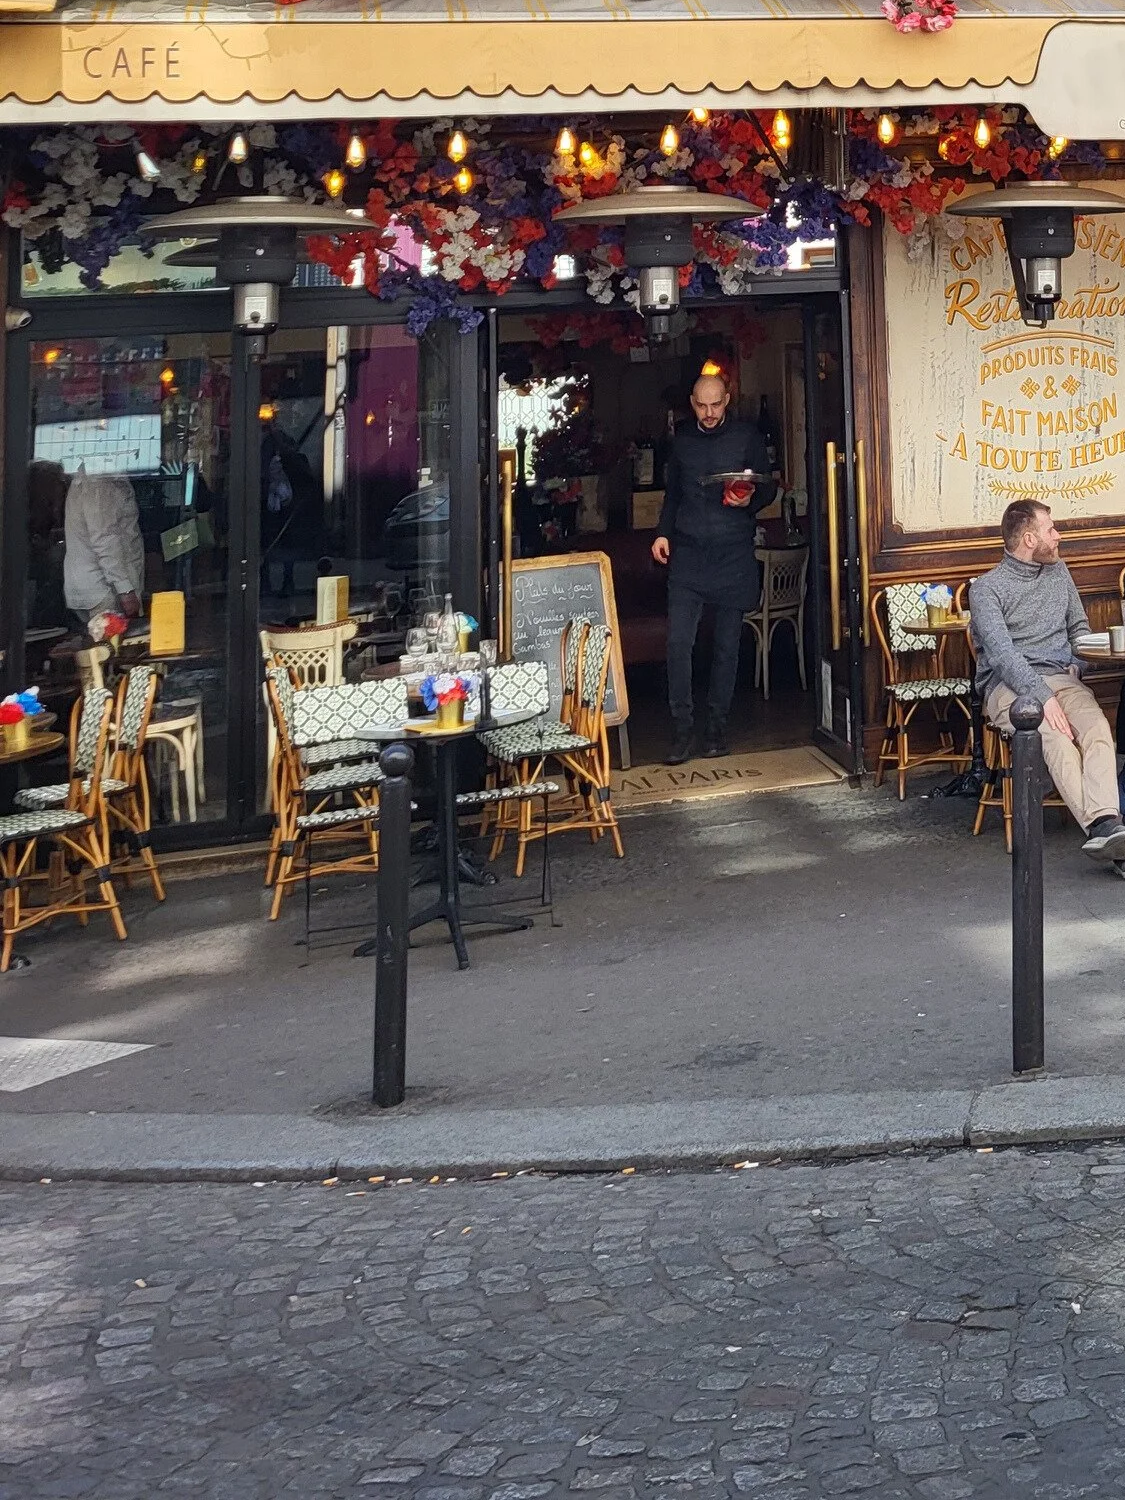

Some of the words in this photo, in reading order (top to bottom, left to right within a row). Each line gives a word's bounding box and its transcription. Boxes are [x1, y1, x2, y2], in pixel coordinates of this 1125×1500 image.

[83, 40, 181, 79] CAFÉ
[980, 345, 1065, 386] PRODUITS
[1069, 346, 1118, 377] FRAIS
[1042, 374, 1059, 399] &
[981, 399, 1032, 437] FAIT
[1036, 392, 1118, 437] MAISON
[975, 439, 1063, 473] TOUTE
[667, 767, 763, 786] PARIS
